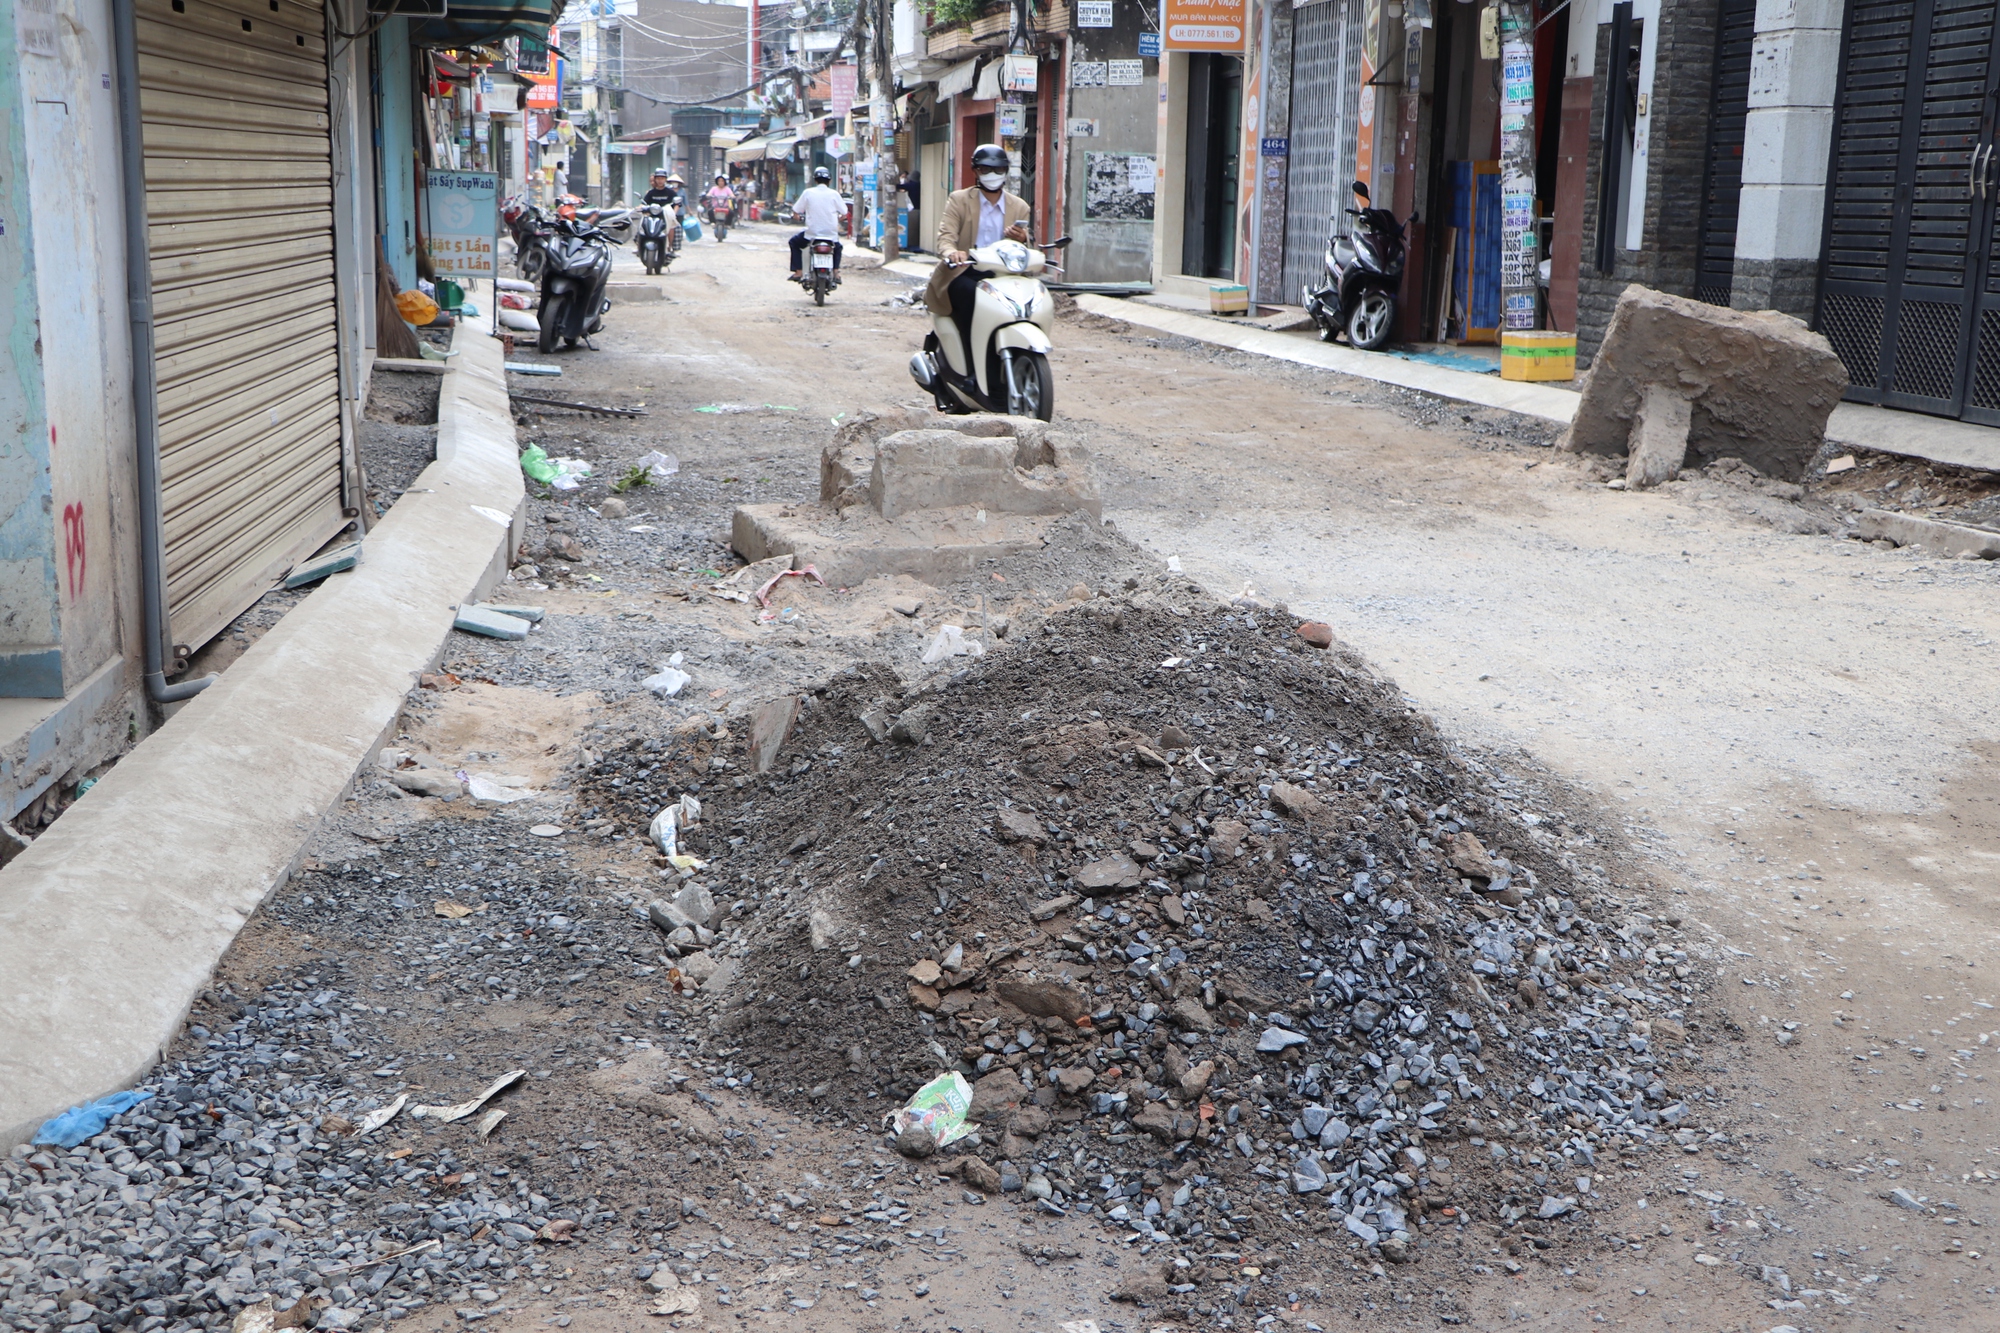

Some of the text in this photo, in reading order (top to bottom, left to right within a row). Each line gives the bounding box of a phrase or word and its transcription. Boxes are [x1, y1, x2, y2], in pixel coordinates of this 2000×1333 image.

[1169, 12, 1242, 23] MUA BÁN NHẠC CỤ
[1264, 140, 1286, 149] 464
[439, 174, 454, 189] Sấy
[456, 176, 494, 190] SupWash
[1503, 229, 1521, 239] GÓP
[455, 240, 462, 252] 5
[466, 237, 491, 253] Lần
[1503, 253, 1520, 261] VAY
[457, 258, 464, 269] 1
[467, 255, 491, 270] Lần
[1503, 262, 1521, 272] GÓP
